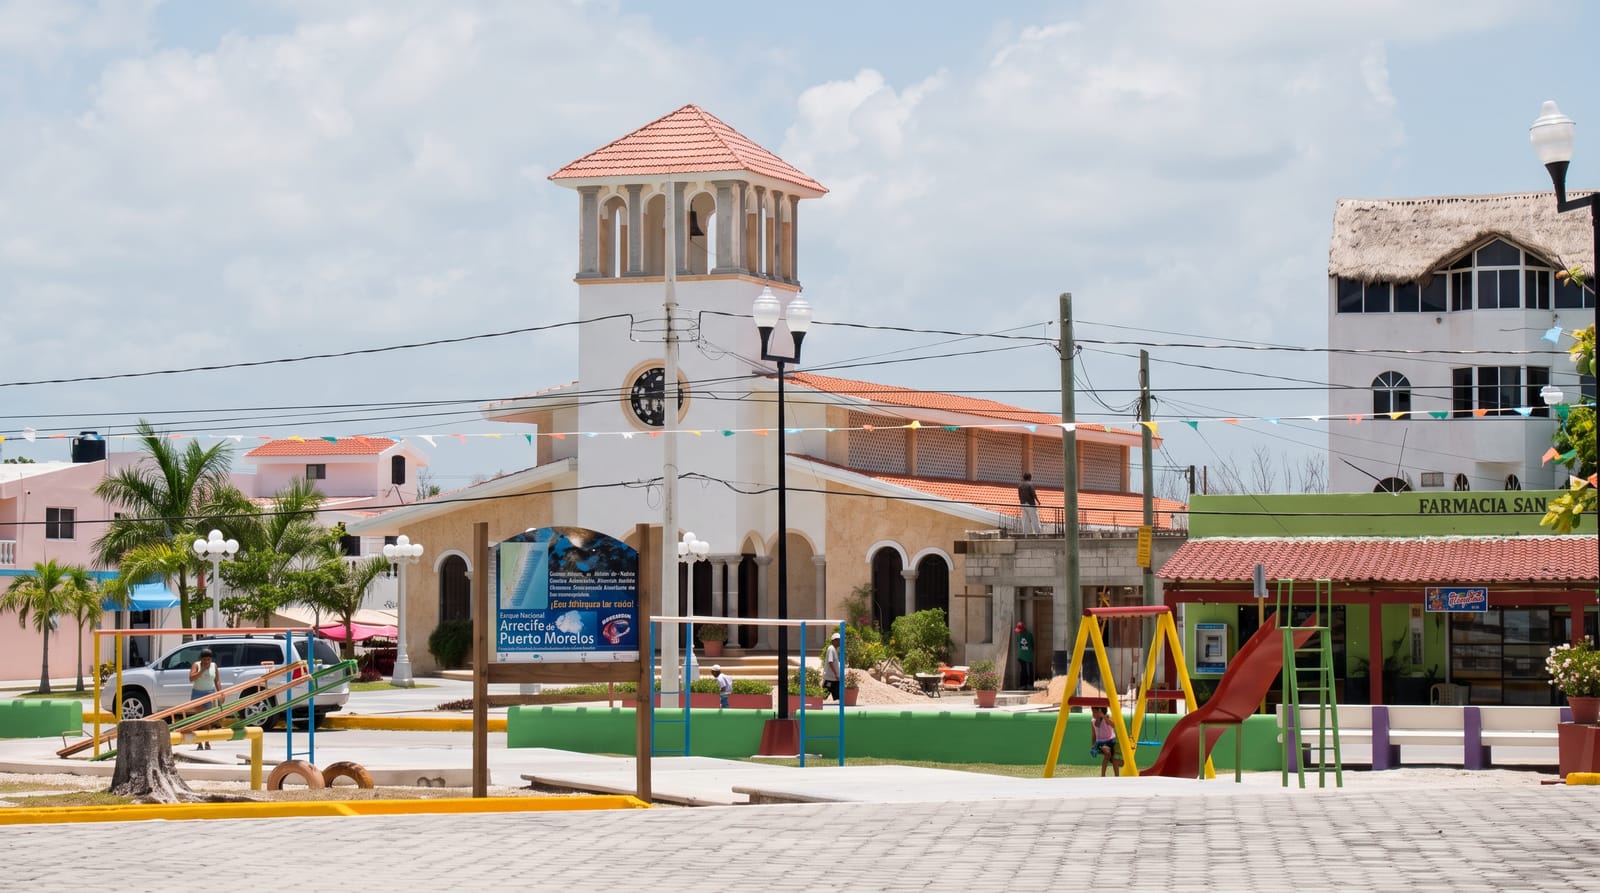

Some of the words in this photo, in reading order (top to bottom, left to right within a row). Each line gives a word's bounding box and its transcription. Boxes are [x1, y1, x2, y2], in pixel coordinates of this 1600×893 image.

[1419, 498, 1507, 513] FARMACIA
[1514, 497, 1547, 512] SAN
[500, 619, 545, 631] Arrecife
[500, 632, 541, 645] Puerto
[544, 632, 594, 645] Morelos
